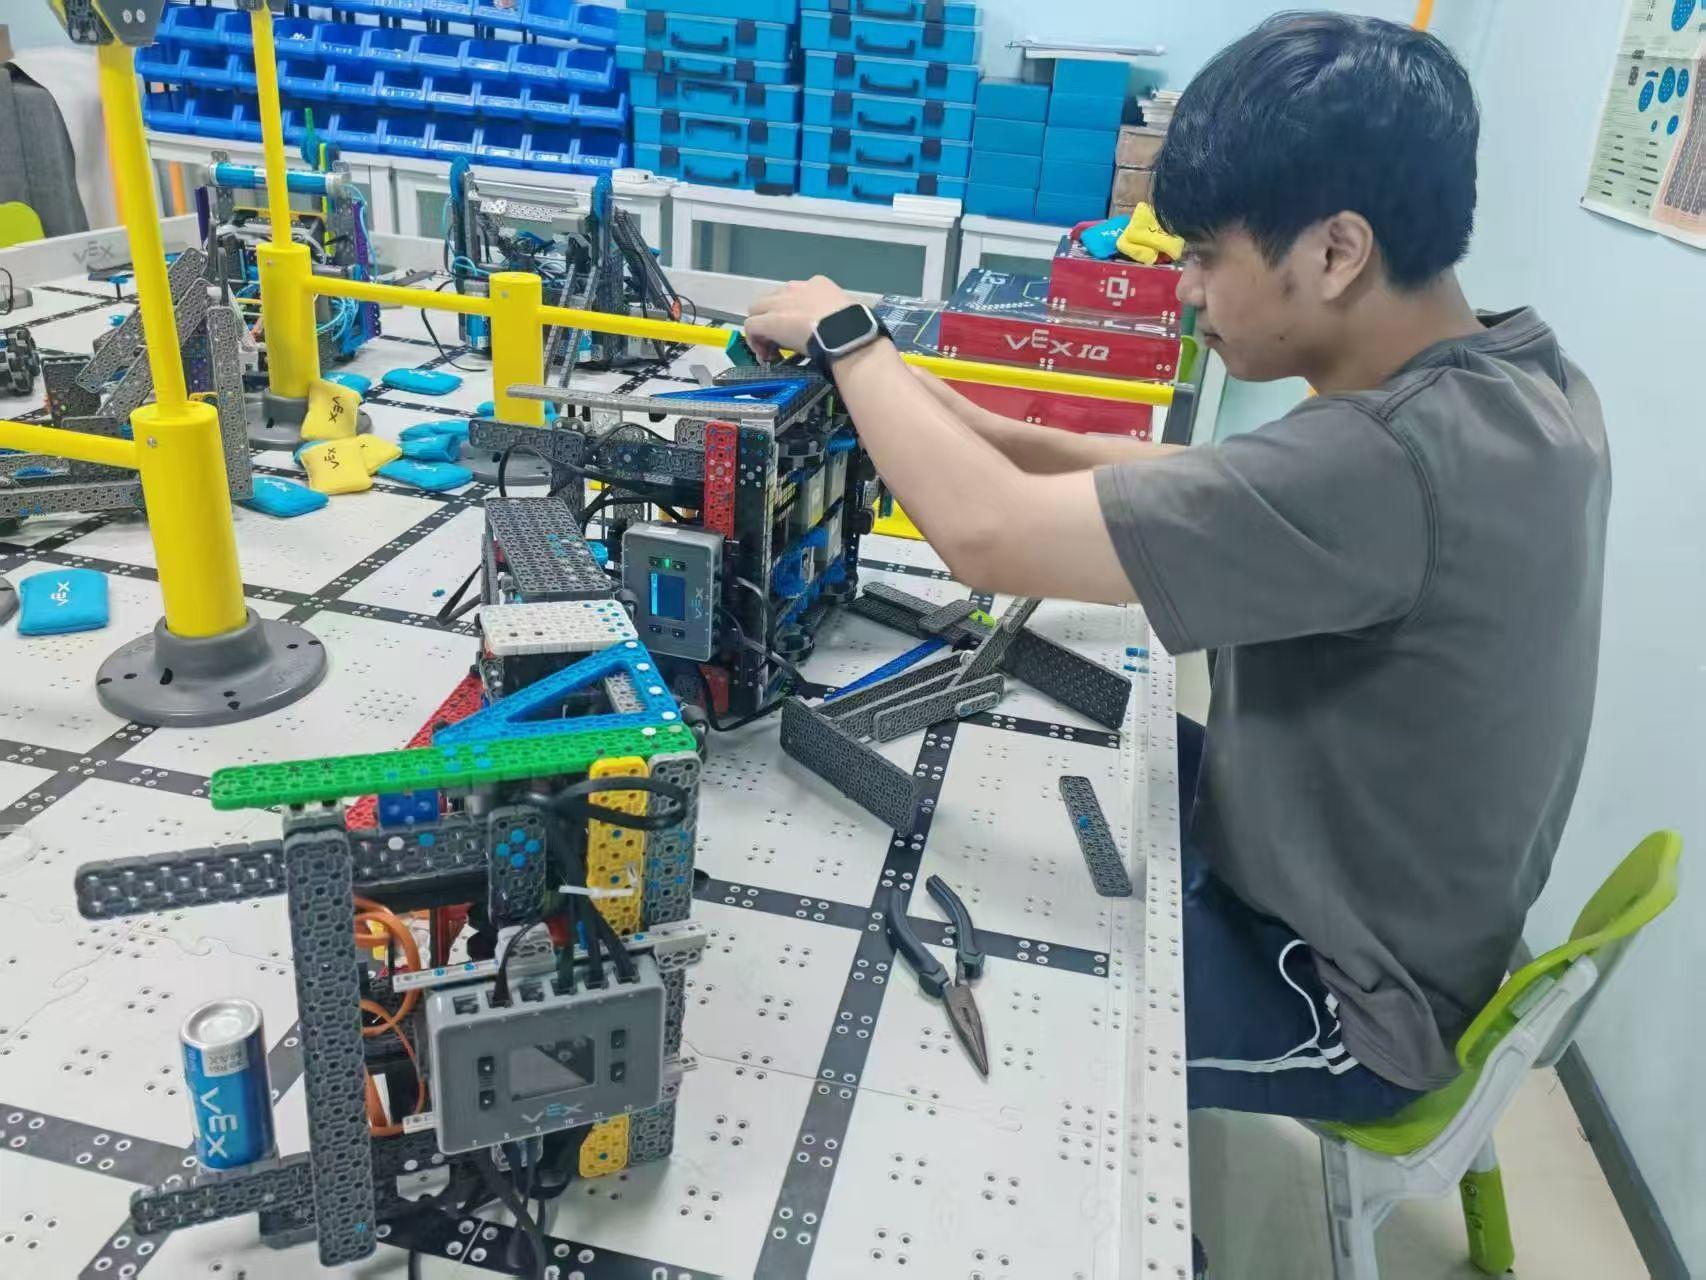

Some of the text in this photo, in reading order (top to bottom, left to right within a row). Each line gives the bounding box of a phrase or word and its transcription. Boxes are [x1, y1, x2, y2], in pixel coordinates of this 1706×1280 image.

[72, 240, 114, 264] VEX
[1004, 328, 1110, 361] VEX IQ
[328, 395, 344, 424] VEX
[323, 446, 341, 470] VEX
[50, 581, 71, 607] VEX
[691, 587, 704, 618] VEX
[200, 1086, 238, 1158] VEX
[521, 1103, 583, 1123] VEX
